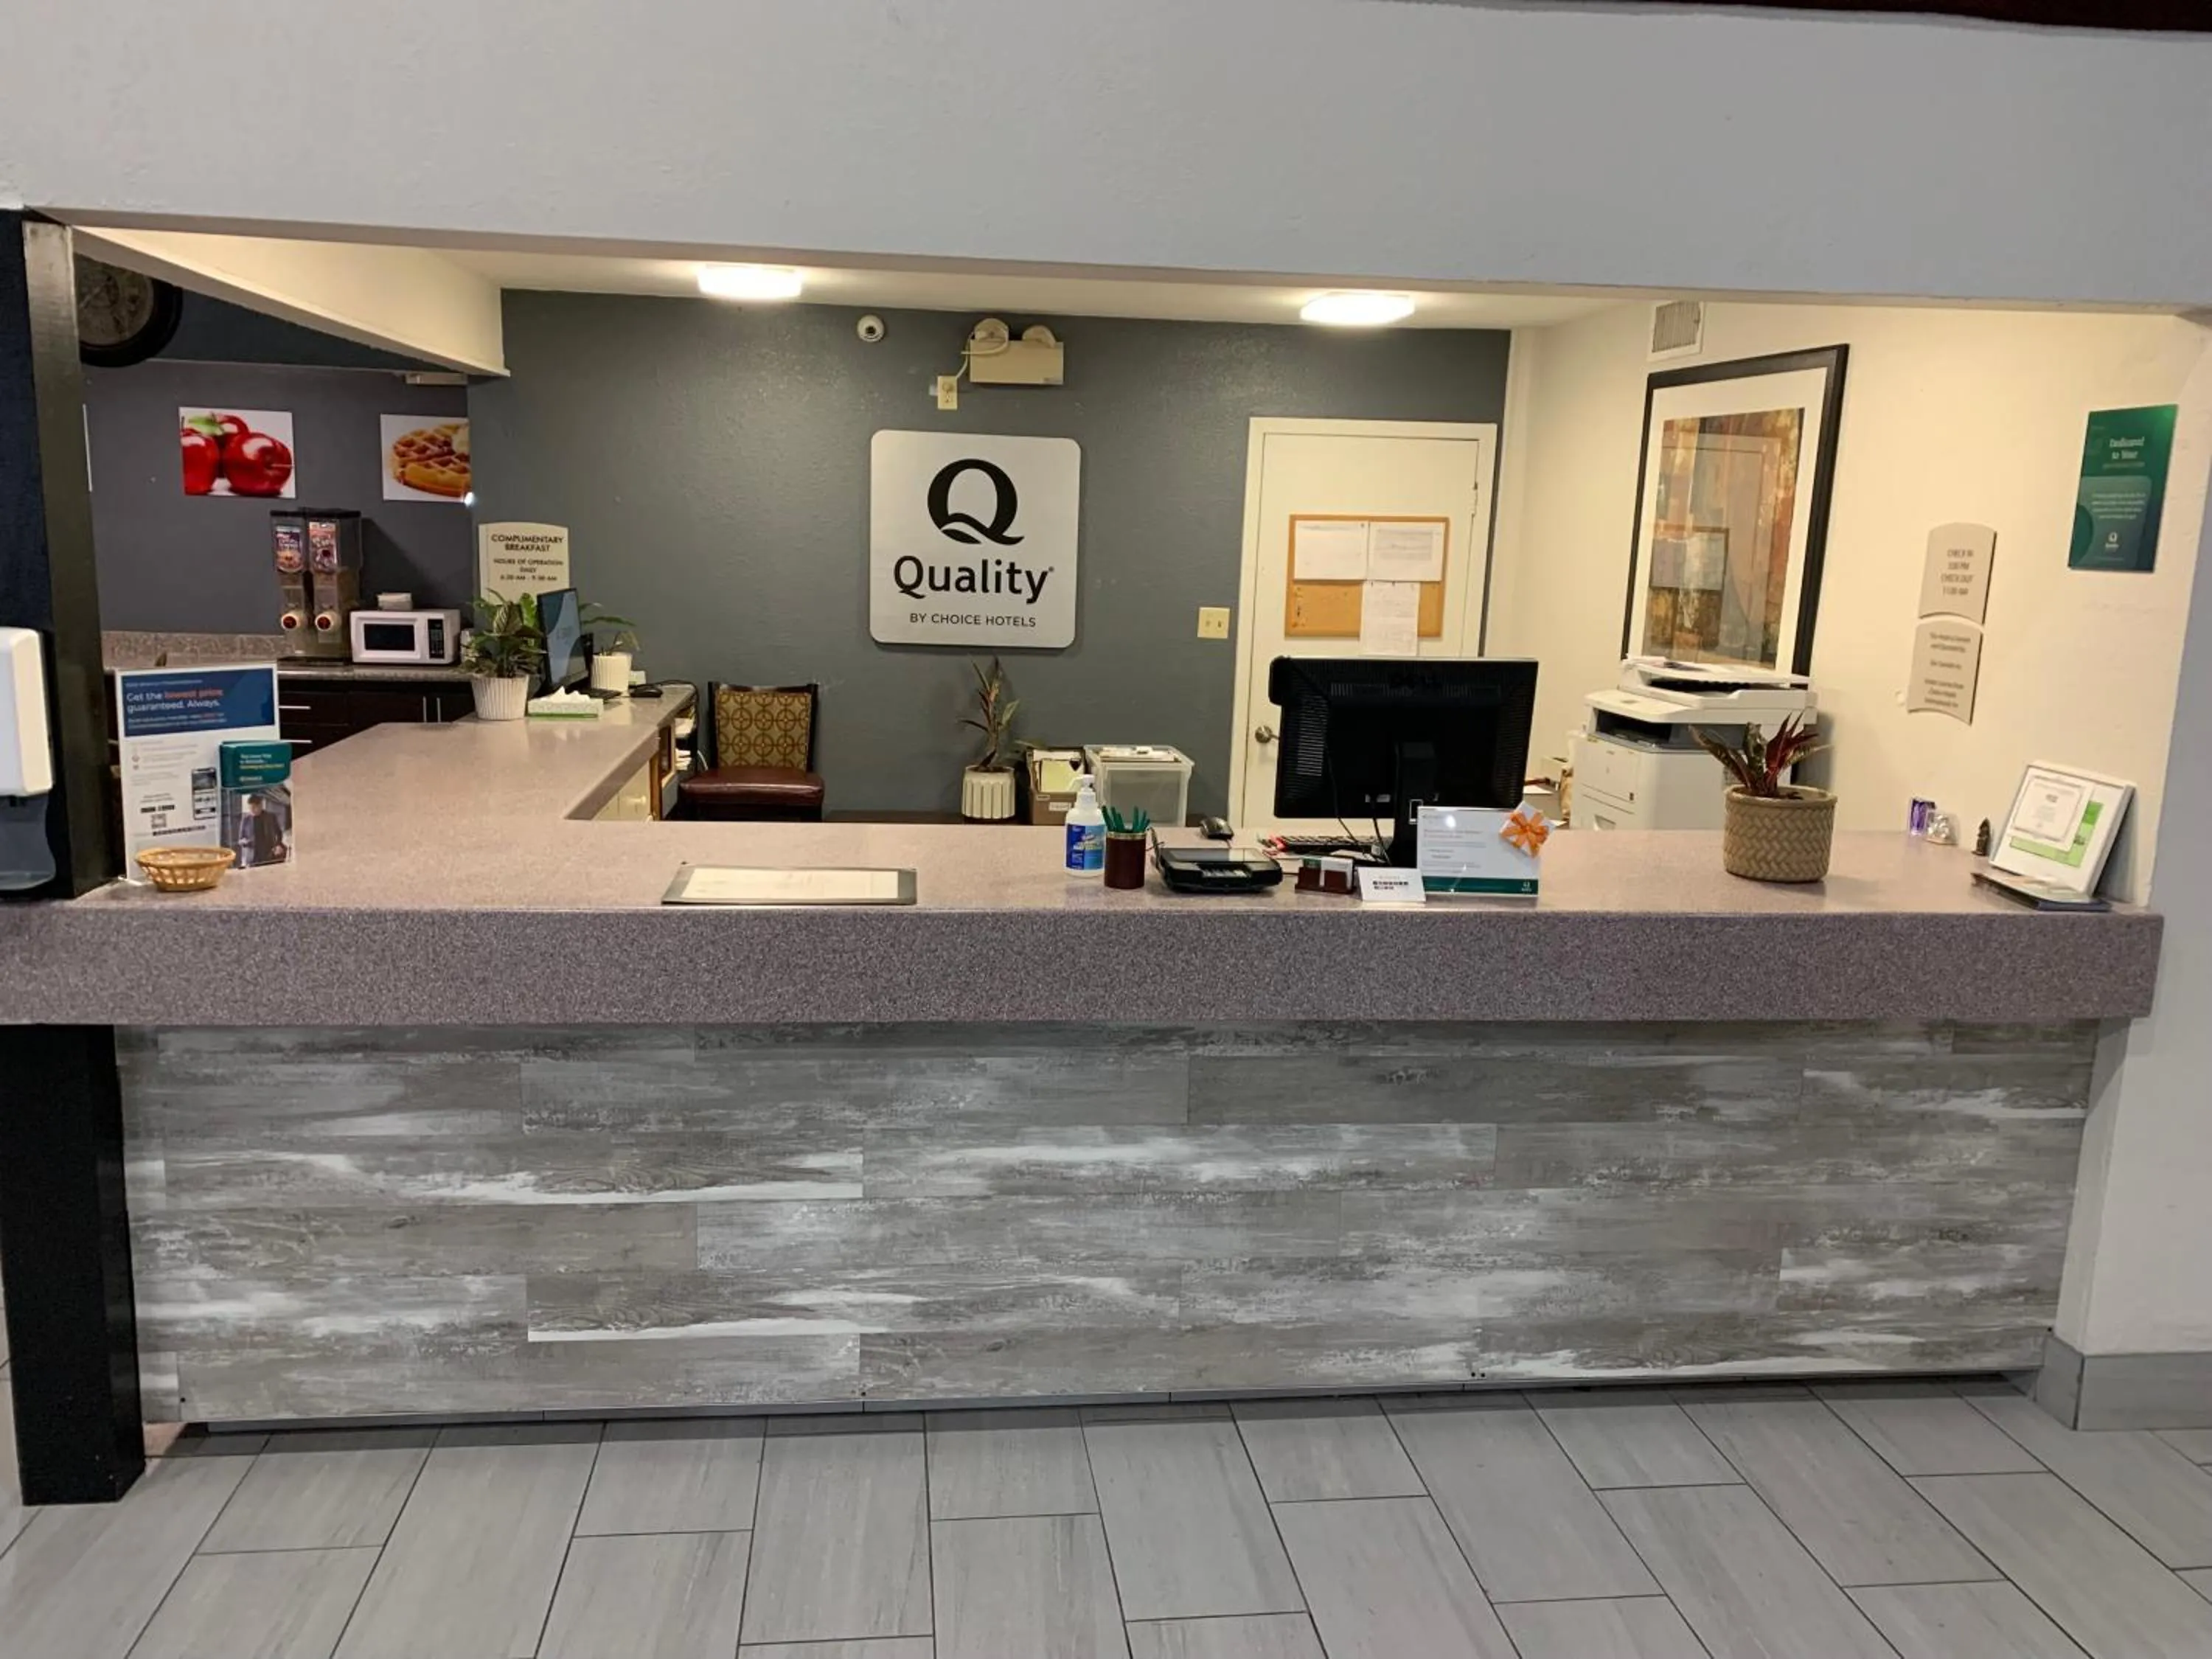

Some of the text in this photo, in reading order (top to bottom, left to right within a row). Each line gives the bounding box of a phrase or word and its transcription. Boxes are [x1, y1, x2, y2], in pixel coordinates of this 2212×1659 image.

[927, 458, 1025, 546] Q
[491, 534, 563, 543] COMPLIMENTARY
[505, 543, 551, 552] BREAKFAST
[894, 555, 1048, 604] Quality
[910, 613, 1036, 627] BY CHOICE HOTELS
[127, 692, 144, 702] Get
[145, 692, 163, 701] the
[127, 699, 220, 714] guaranteed. Always.
